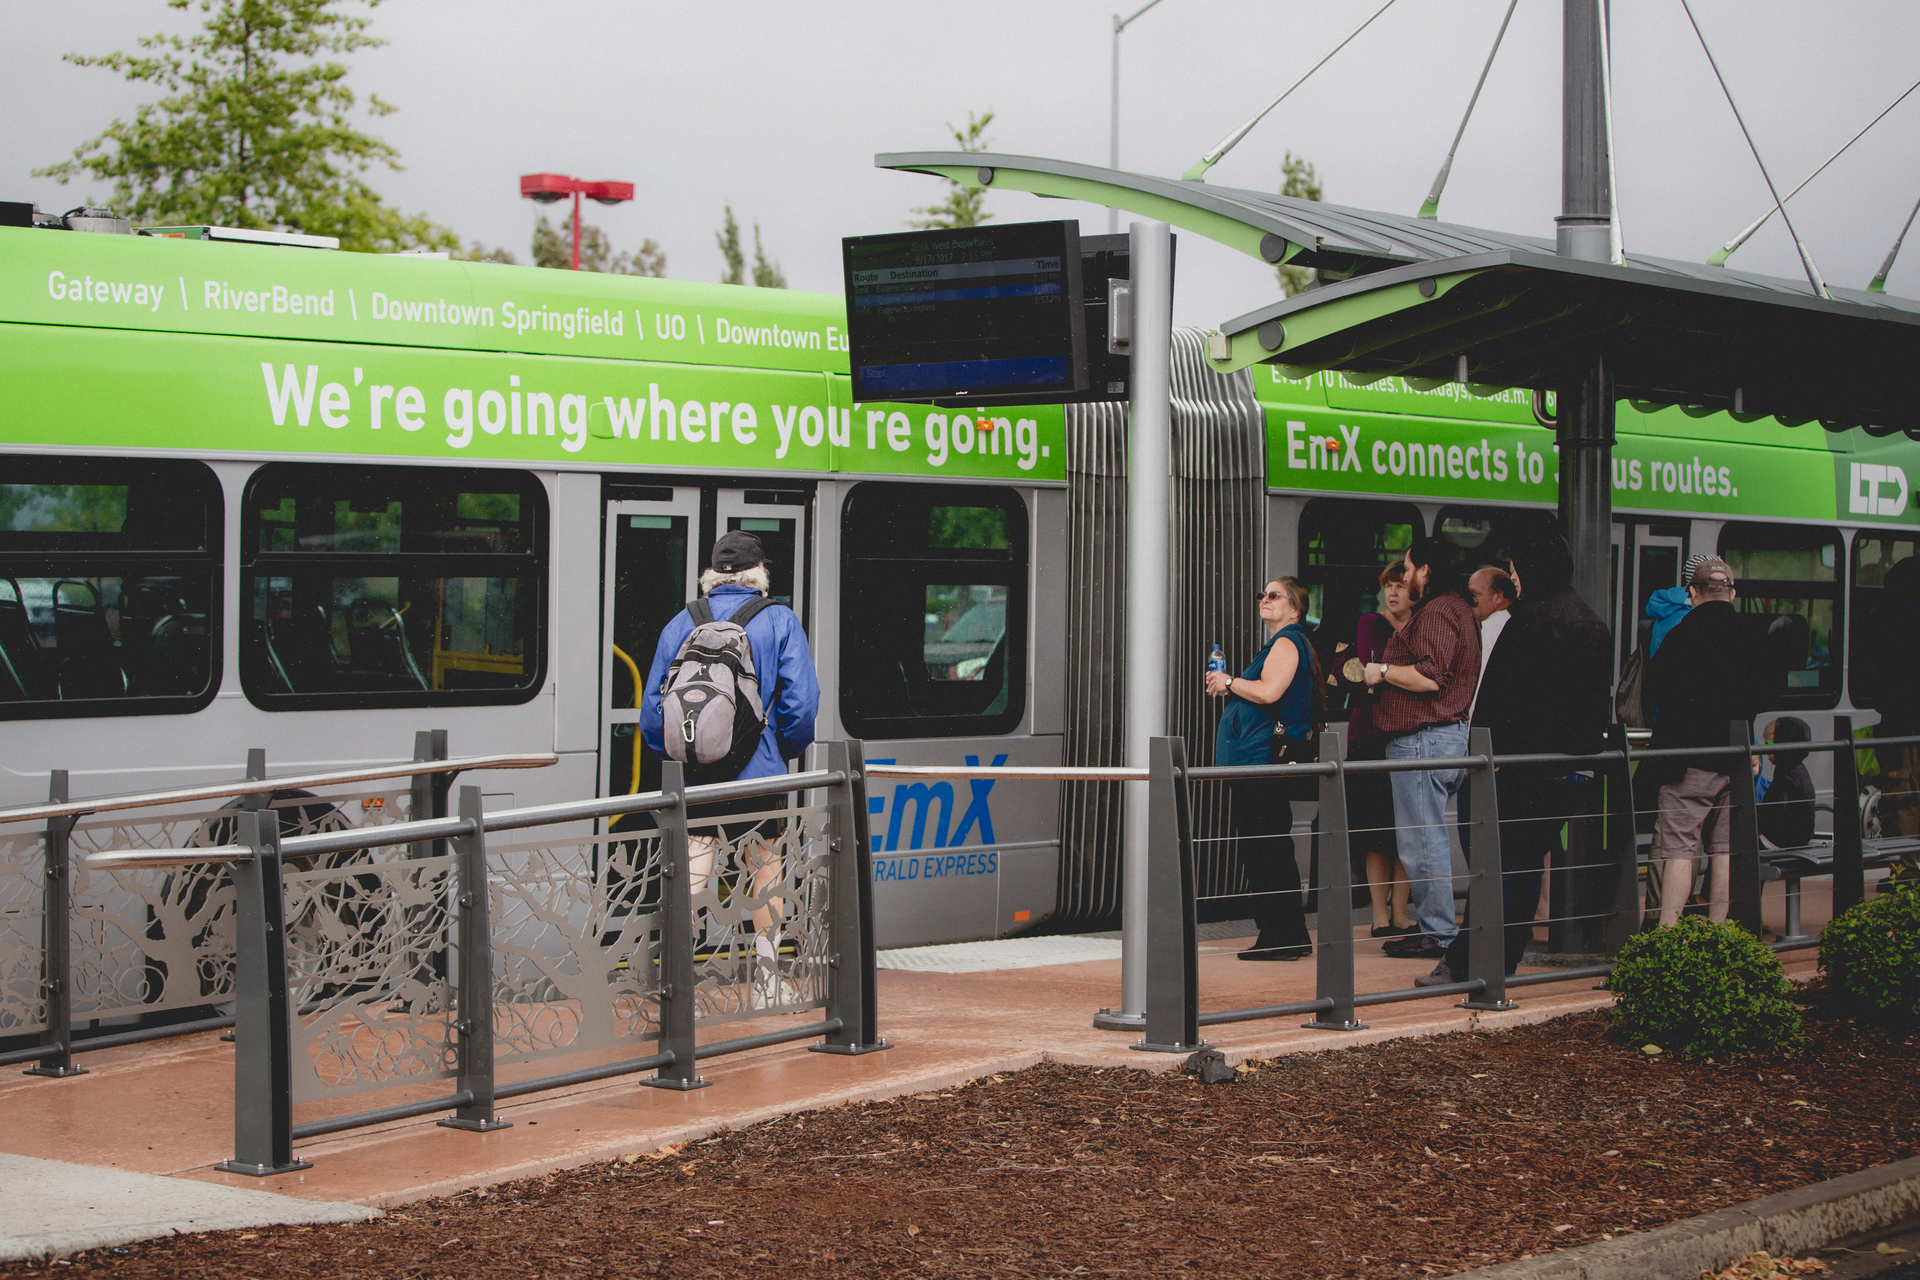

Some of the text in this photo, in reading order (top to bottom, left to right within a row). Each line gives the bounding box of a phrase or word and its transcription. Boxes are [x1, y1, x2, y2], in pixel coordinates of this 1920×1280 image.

[912, 238, 994, 252] EmX West Departures
[915, 253, 953, 265] 9/17/2017
[961, 251, 979, 261] 2:15
[981, 250, 993, 259] PM
[854, 259, 1059, 282] Route Destination Time
[855, 286, 869, 294] EmX
[1049, 272, 1060, 280] PM
[1050, 283, 1061, 292] PM
[48, 270, 164, 313] Gateway
[204, 280, 335, 317] RiverBend
[372, 292, 495, 327] Downtown
[501, 301, 624, 339] Springfield
[655, 313, 686, 341] UO
[716, 318, 820, 350] Downtown
[826, 326, 849, 352] Eu
[856, 307, 871, 316] EmX
[1050, 294, 1061, 302] PM
[866, 368, 886, 379] Stop!
[261, 362, 1050, 470] We're going where you're going.
[1286, 420, 1362, 473] EmX
[1372, 438, 1508, 482] connects
[1516, 442, 1544, 484] to
[1612, 457, 1643, 491] us
[1651, 456, 1738, 497] routes.
[1849, 461, 1908, 517] LTD
[872, 852, 998, 882] RALD EXPRESS
